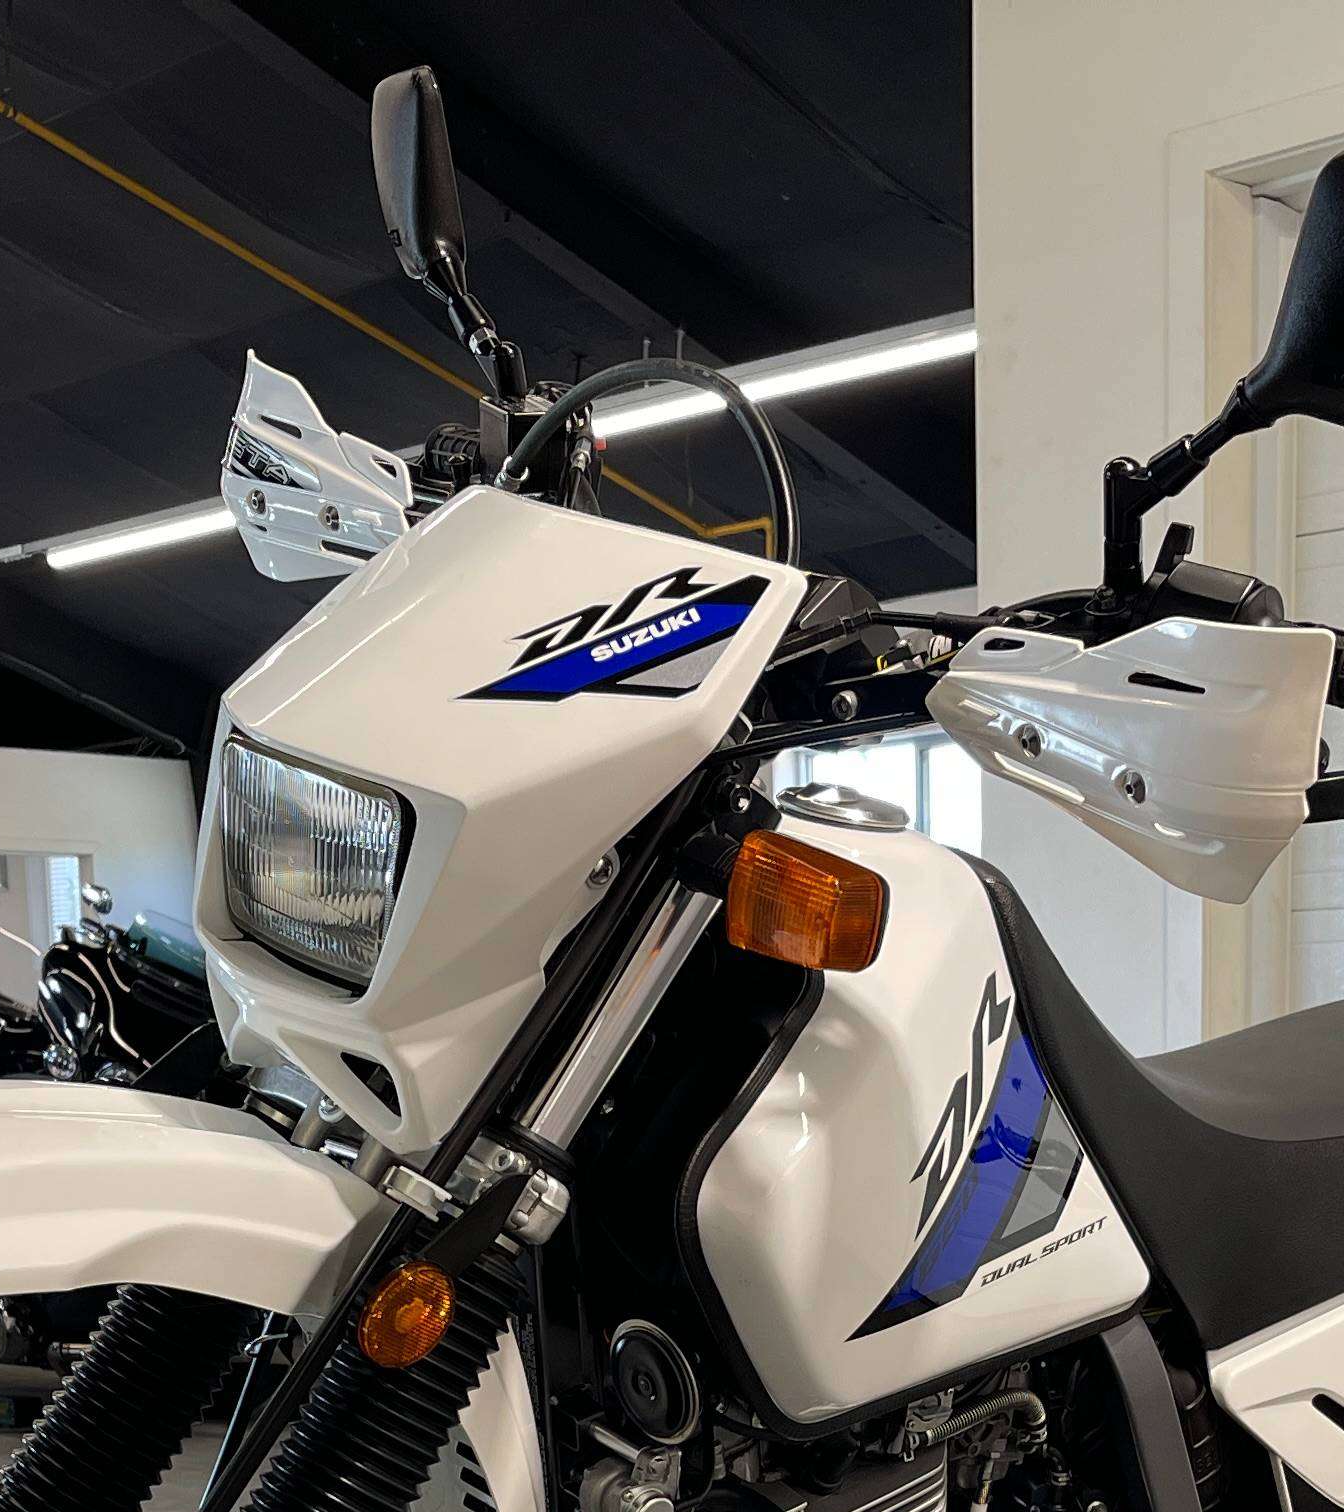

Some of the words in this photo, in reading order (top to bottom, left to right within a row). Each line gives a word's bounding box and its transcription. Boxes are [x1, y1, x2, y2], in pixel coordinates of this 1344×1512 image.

[590, 606, 701, 663] SUZUKI
[980, 1255, 1038, 1288] DUAL
[1040, 1216, 1107, 1258] SPORT
